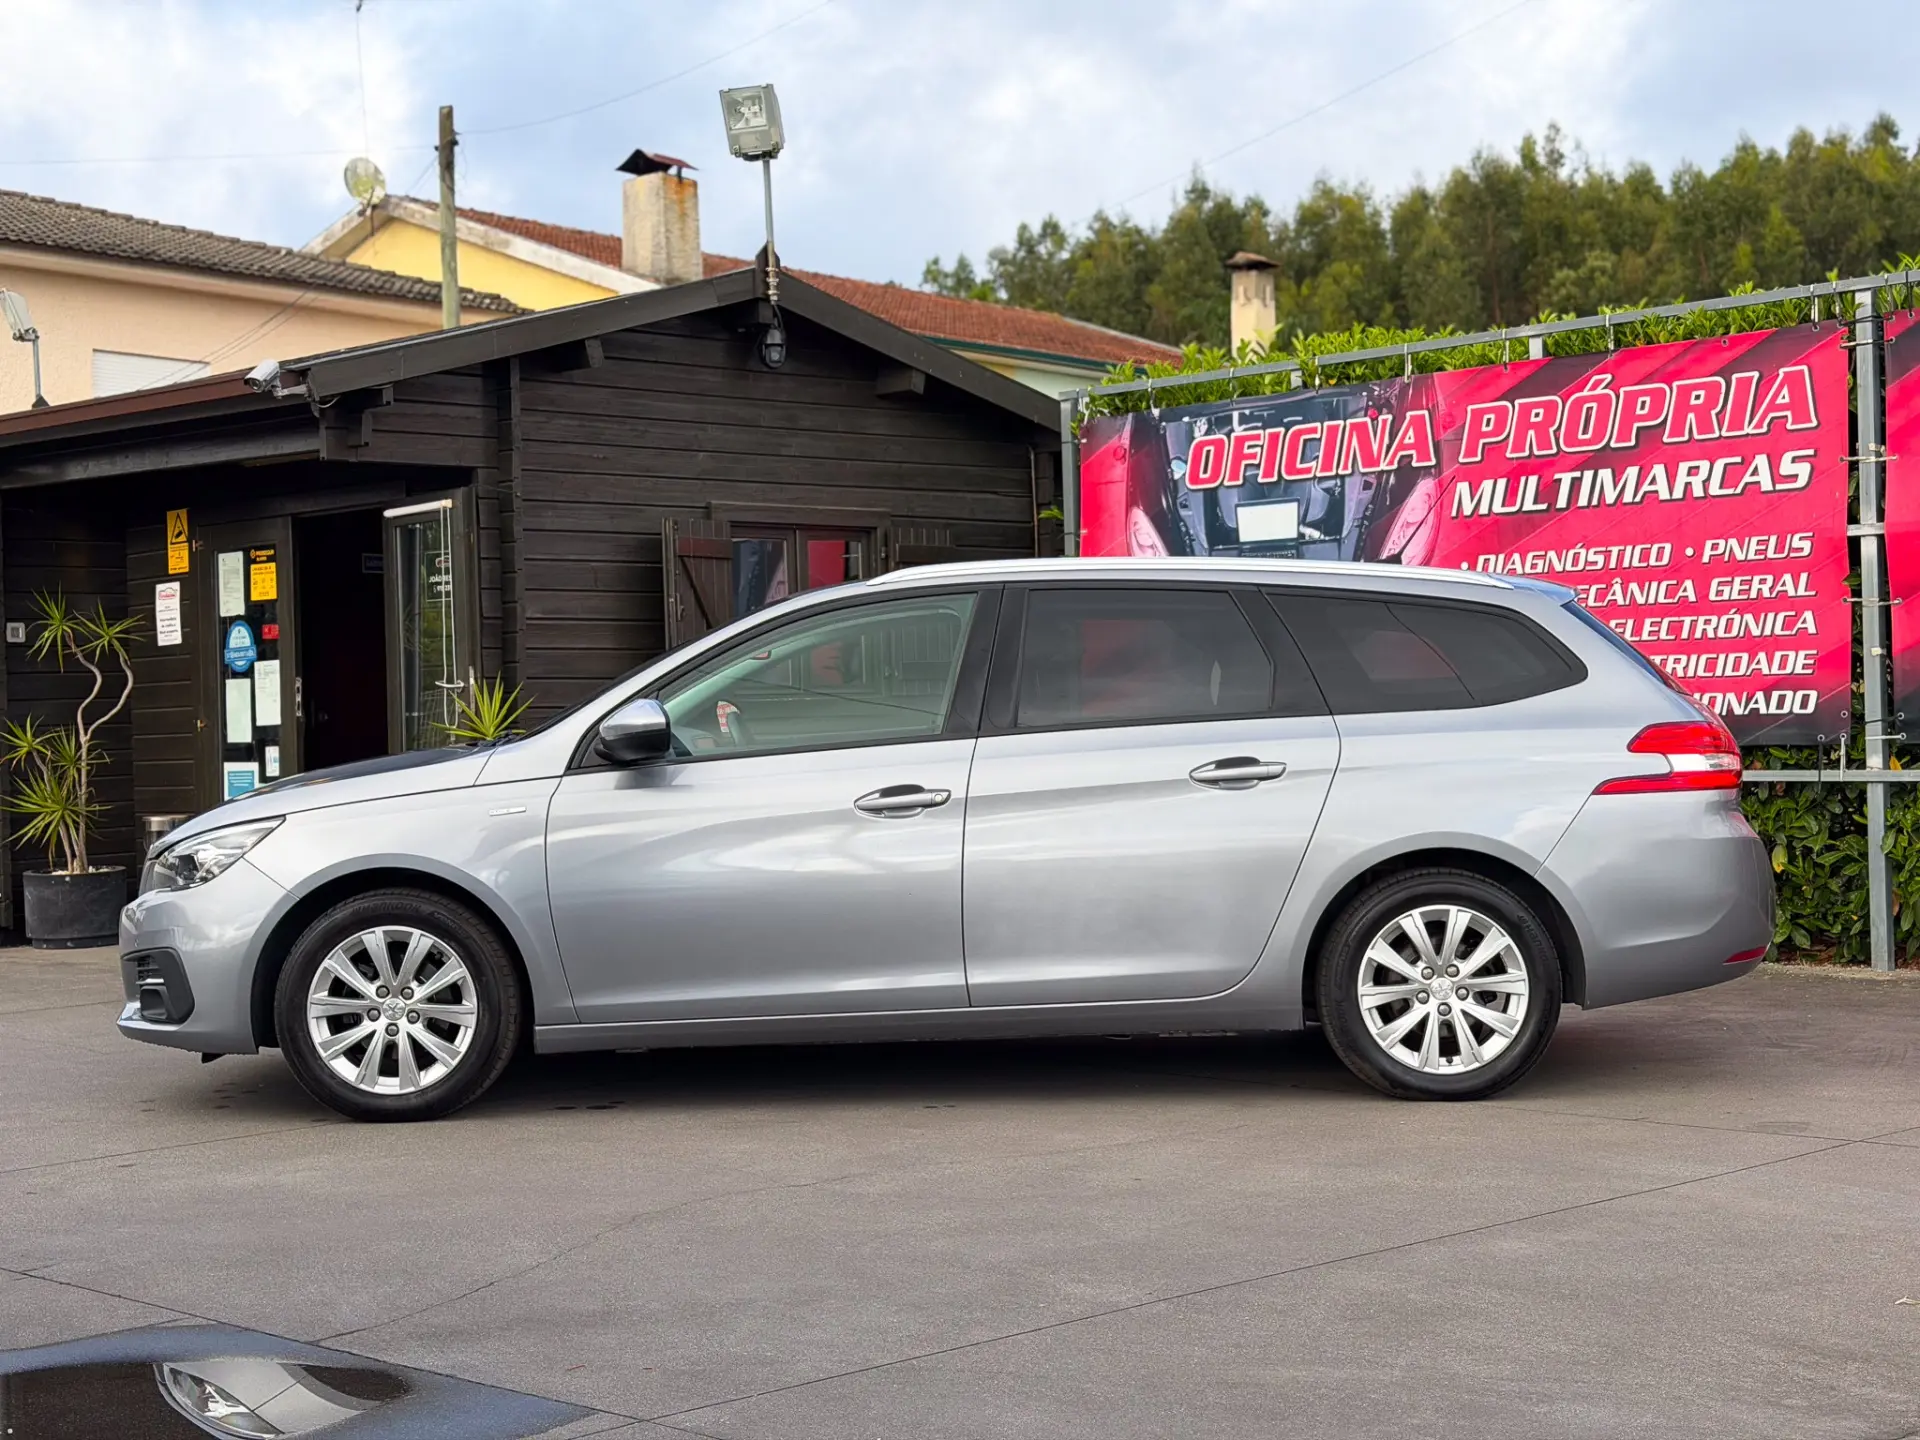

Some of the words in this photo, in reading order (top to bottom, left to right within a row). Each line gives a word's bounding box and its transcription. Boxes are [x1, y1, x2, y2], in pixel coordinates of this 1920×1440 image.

[1185, 409, 1436, 490] OFICINA
[1458, 365, 1818, 464] PRÓPRIA
[1450, 449, 1815, 518] MULTIMARCAS
[1476, 543, 1672, 575] DIAGNÓSTICO
[1701, 532, 1815, 564] PNEUS
[1708, 572, 1818, 602] GERAL
[1610, 608, 1818, 641] ELECTRÓNICA
